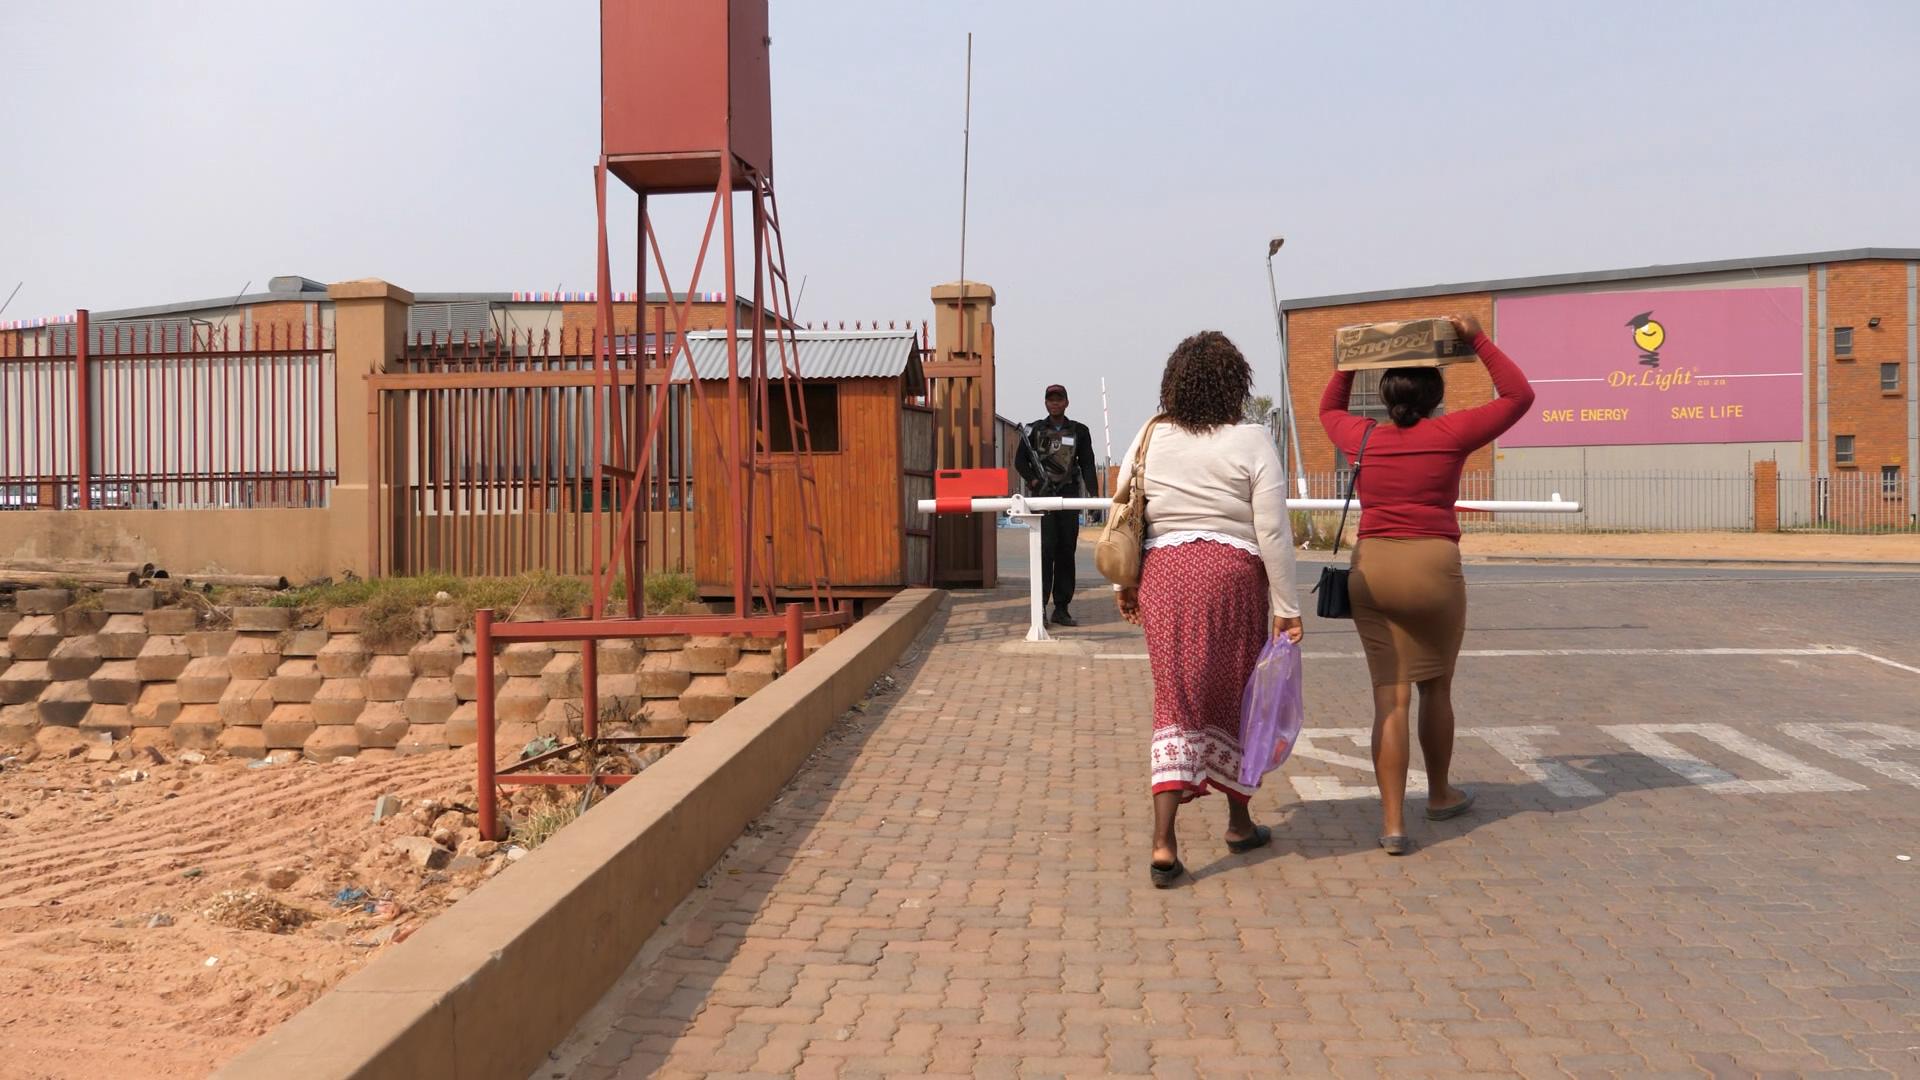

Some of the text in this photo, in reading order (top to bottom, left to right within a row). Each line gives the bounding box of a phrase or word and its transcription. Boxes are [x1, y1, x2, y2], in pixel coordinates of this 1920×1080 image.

[1607, 367, 1692, 391] Dr.Light
[1542, 408, 1629, 422] SAVE ENERGY
[1671, 405, 1744, 420] SAVE LIFE
